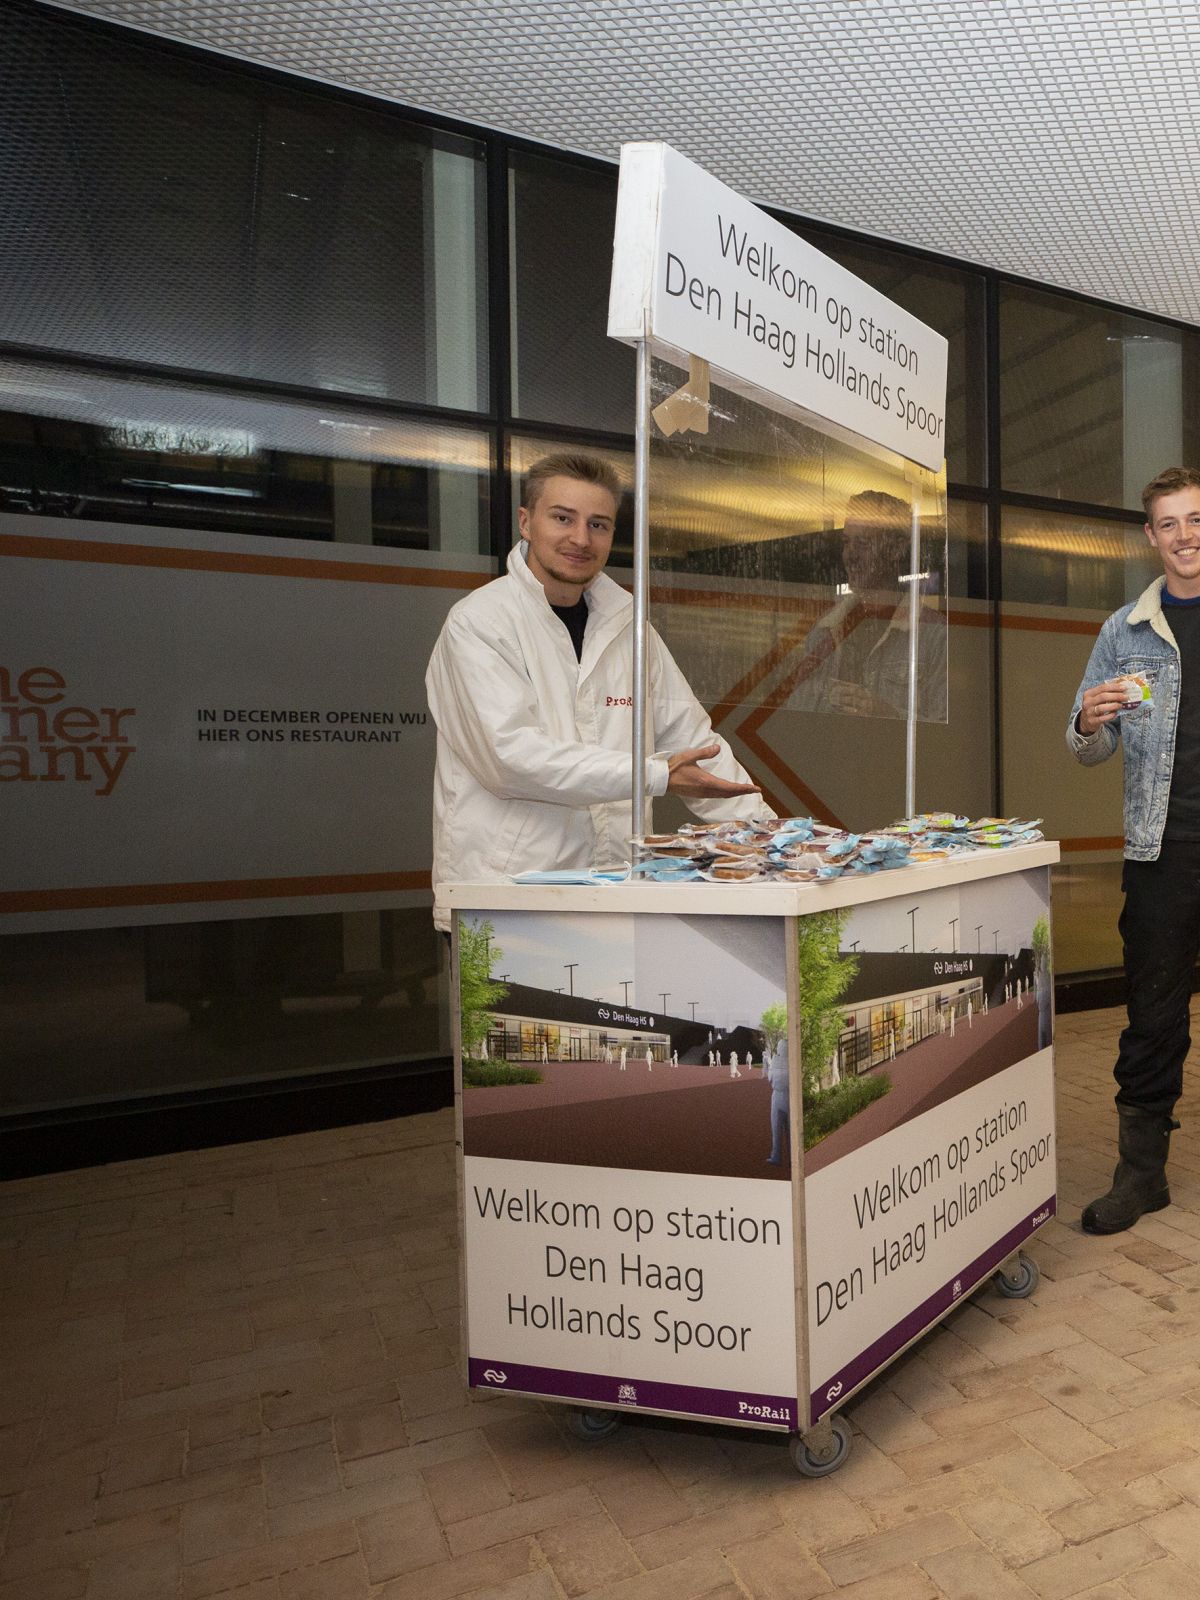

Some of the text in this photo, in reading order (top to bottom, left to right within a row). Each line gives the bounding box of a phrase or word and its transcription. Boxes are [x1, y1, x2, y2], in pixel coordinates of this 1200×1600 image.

[717, 213, 918, 376] Welkom op station
[665, 251, 943, 439] Den Haag Hollands Spoor
[197, 709, 427, 725] IN DECEMBER OPENEN WIJ
[198, 729, 402, 743] HIER ONS RESTAURANT
[613, 1011, 624, 1021] Den
[625, 1014, 639, 1026] Haag
[854, 1100, 1027, 1230] Welkom op station
[474, 1186, 781, 1245] Welkom op station
[816, 1133, 1051, 1327] Den Haag Hollands Spoor
[546, 1246, 703, 1302] Den Haag
[507, 1293, 752, 1354] Hollands Spoor
[738, 1401, 791, 1421] ProRail
